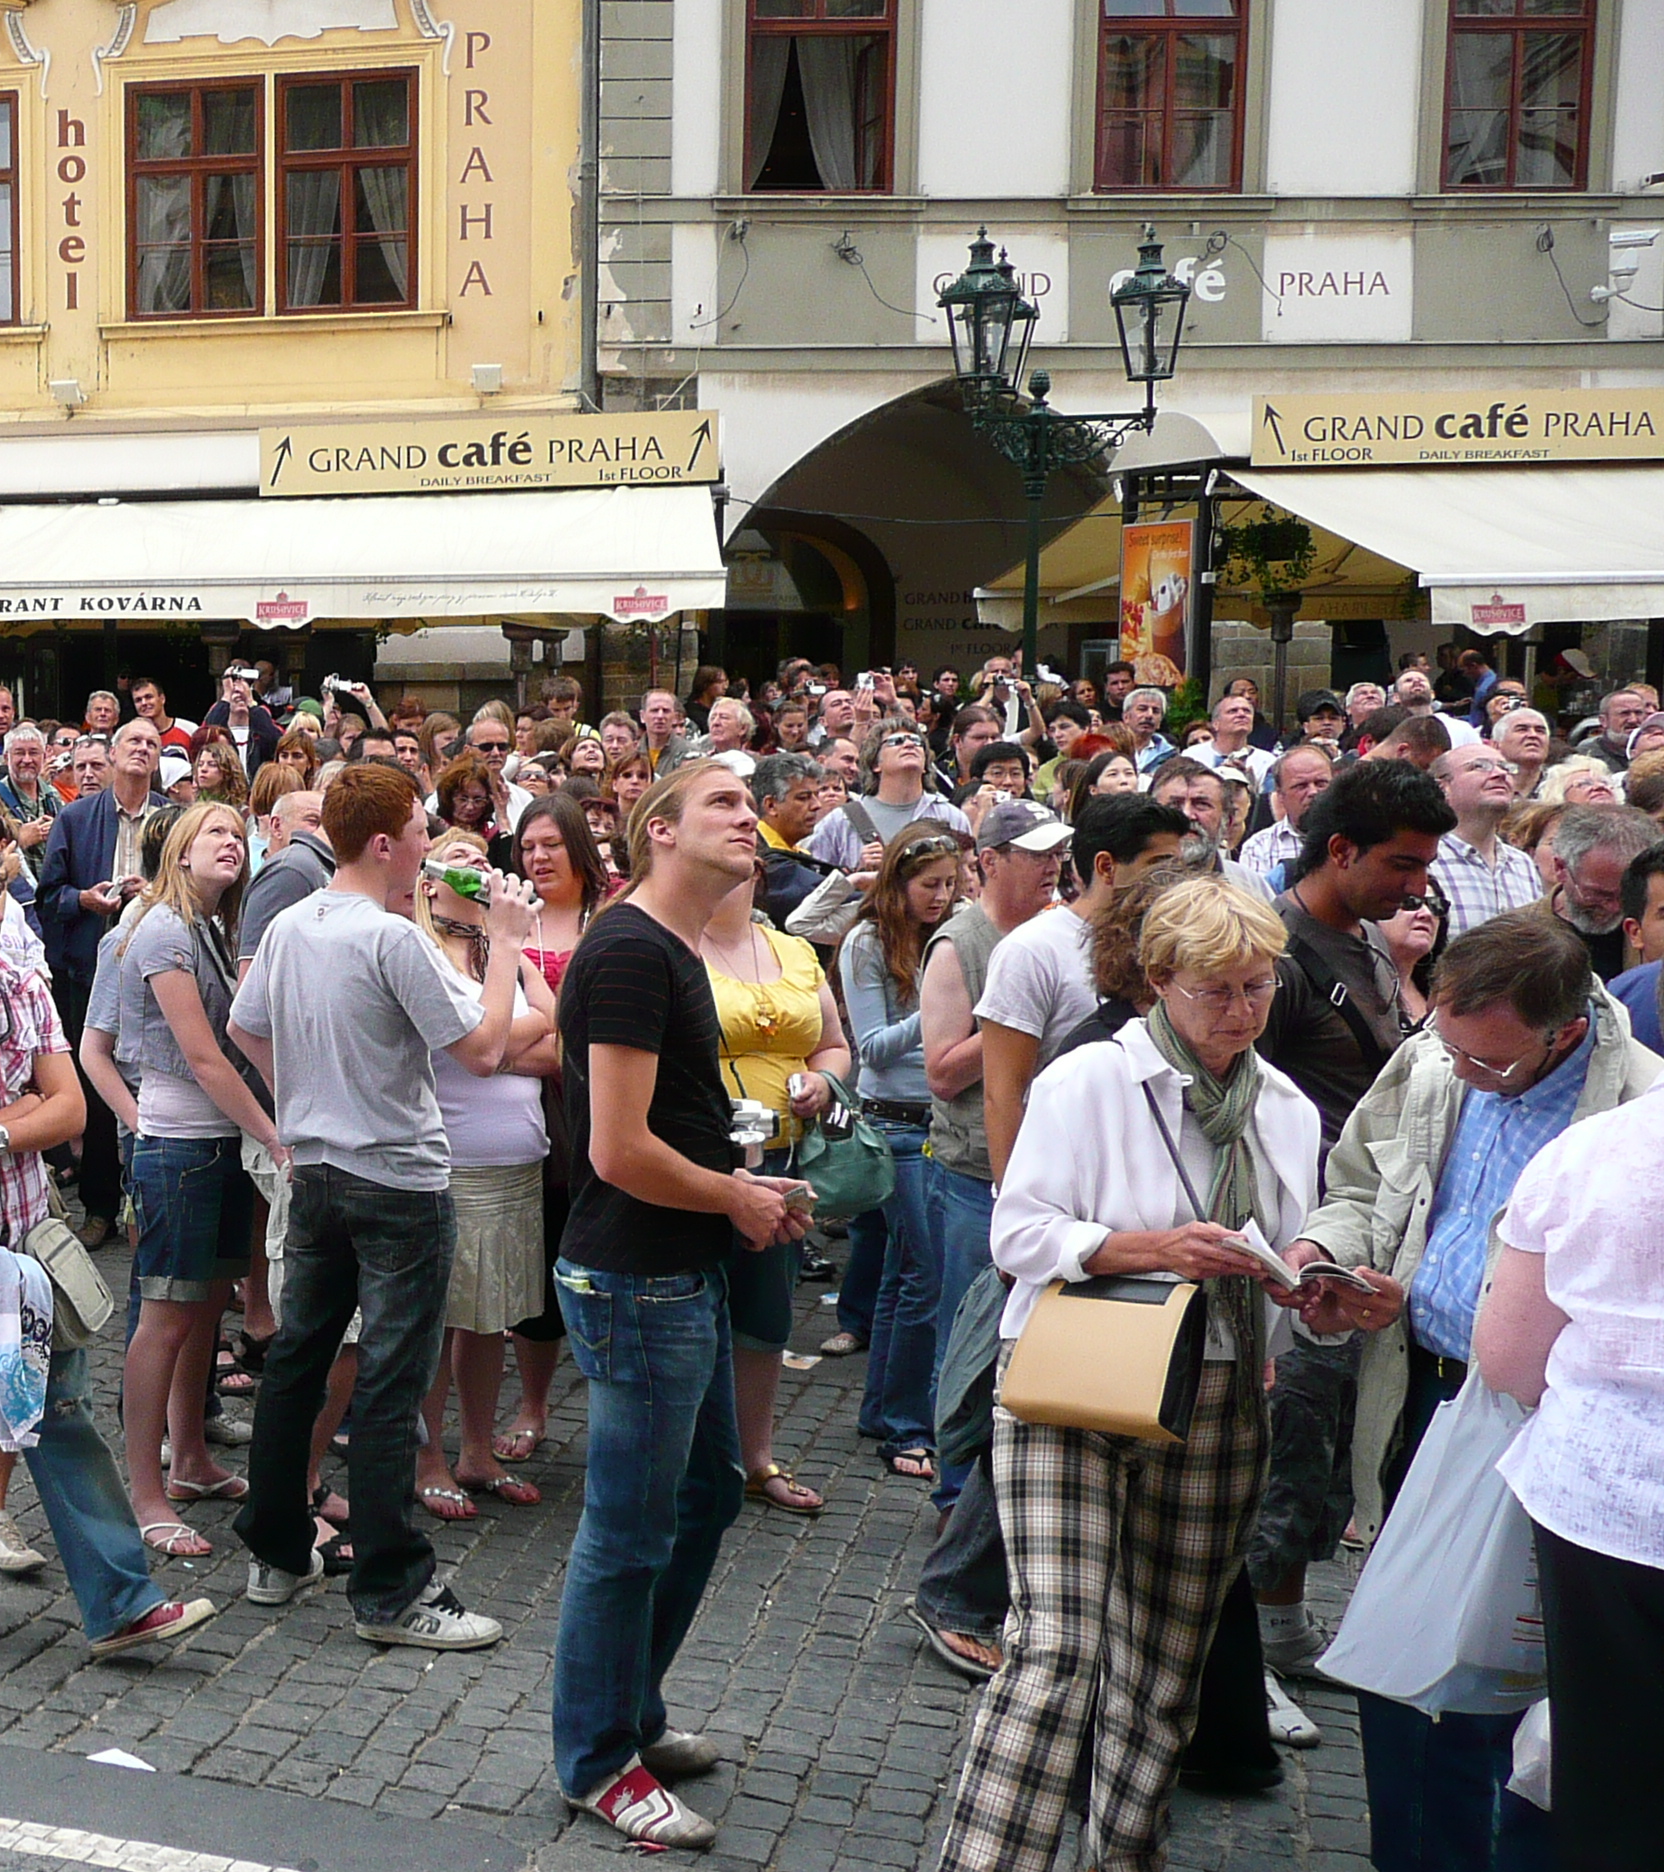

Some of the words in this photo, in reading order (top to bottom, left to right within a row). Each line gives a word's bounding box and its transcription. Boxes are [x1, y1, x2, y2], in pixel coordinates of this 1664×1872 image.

[460, 32, 493, 298] PRAHA
[57, 109, 86, 310] hotel
[1280, 271, 1390, 297] PRAHA
[1303, 415, 1423, 442] GRAND
[1435, 403, 1529, 439] café
[1543, 411, 1656, 438] PRAHA
[308, 445, 426, 473] GRAND
[437, 431, 532, 468] café
[548, 436, 664, 464] PRAHA
[1312, 448, 1373, 461] FLOOR
[1419, 450, 1461, 460] DAILY
[1465, 448, 1550, 459] BREAKFAST
[420, 476, 462, 487] DAILY
[466, 473, 553, 485] BREAKFAST
[620, 466, 682, 481] FLOOR
[79, 592, 203, 613] KOVÁRNA
[904, 592, 960, 606] GRAND
[903, 616, 957, 631] GRAND
